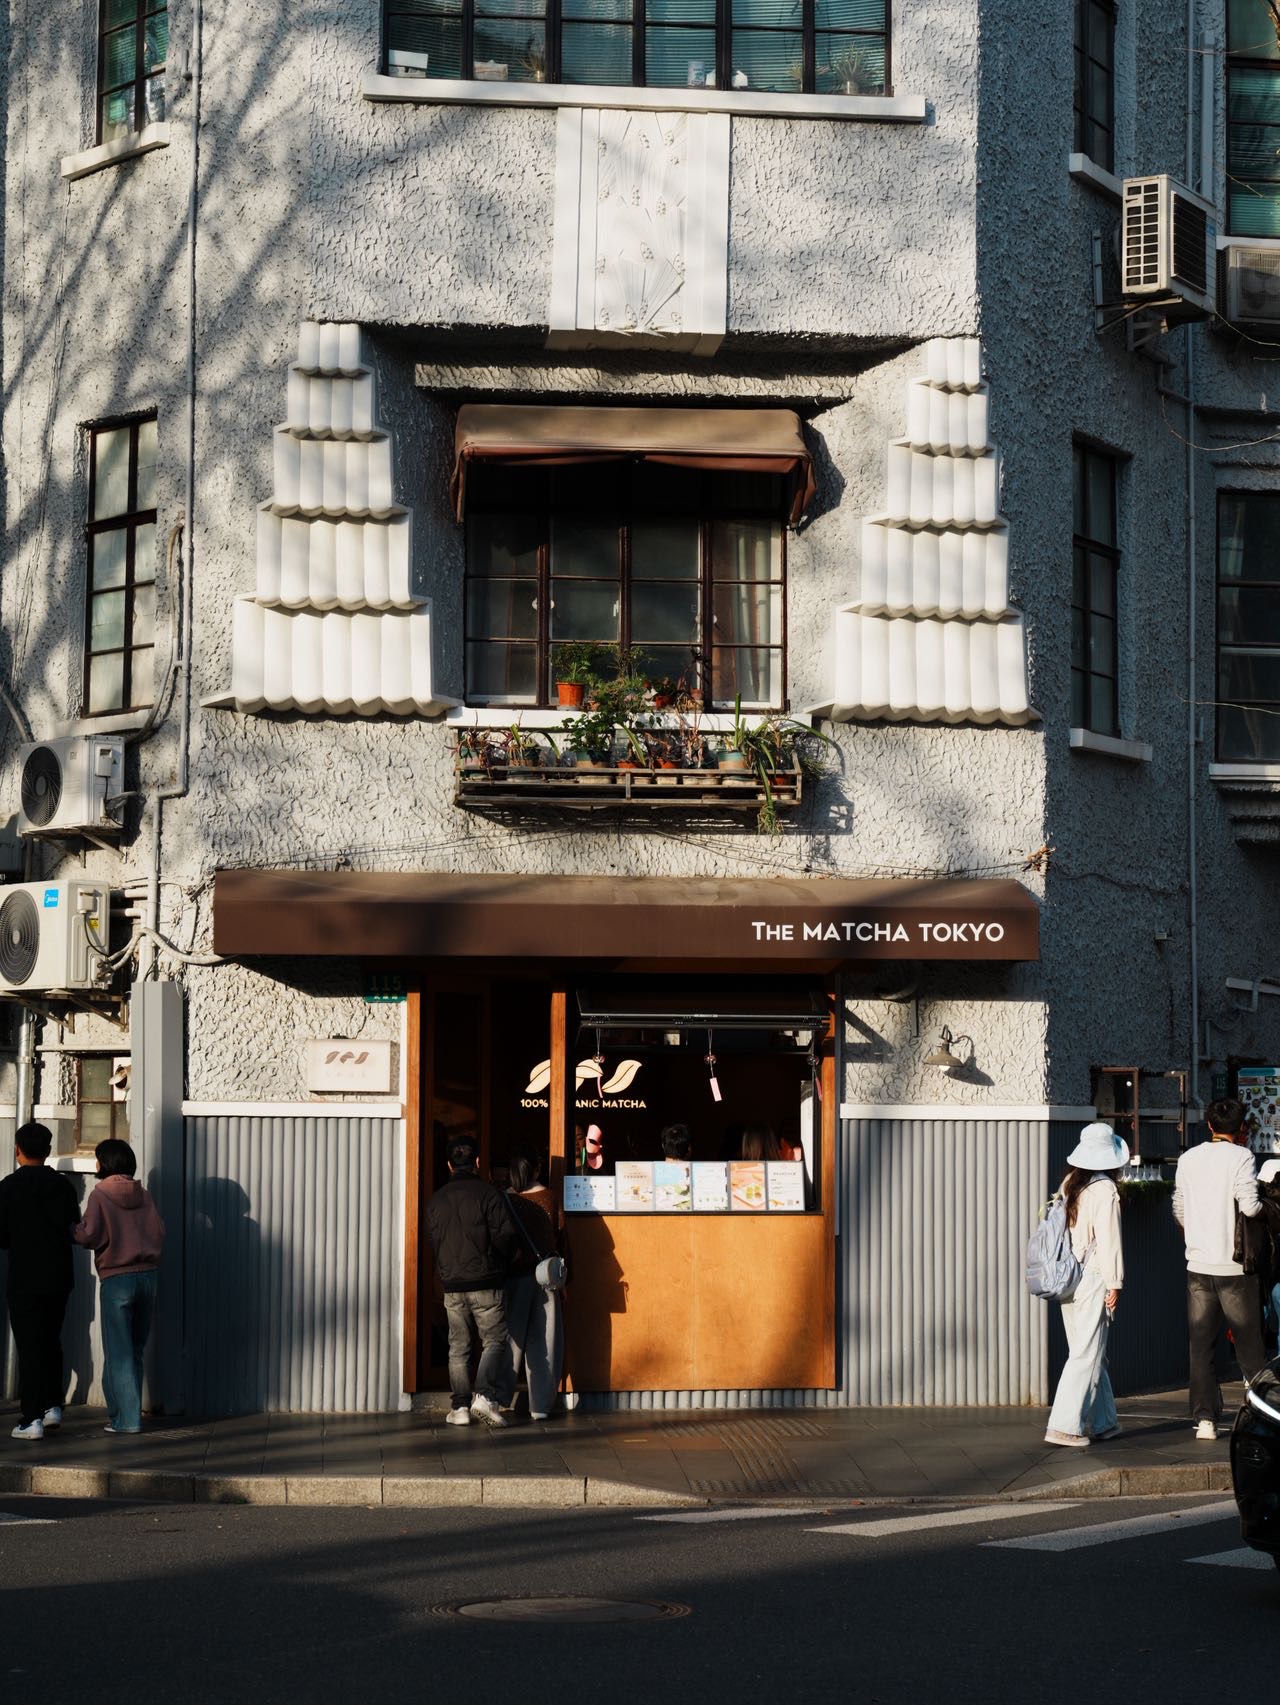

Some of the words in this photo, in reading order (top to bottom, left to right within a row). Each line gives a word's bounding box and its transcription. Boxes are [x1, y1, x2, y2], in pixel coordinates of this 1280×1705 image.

[802, 921, 910, 942] MATCHA
[918, 922, 1005, 942] TOKYO
[520, 1098, 549, 1108] 100%
[602, 1099, 647, 1109] MATCHA
